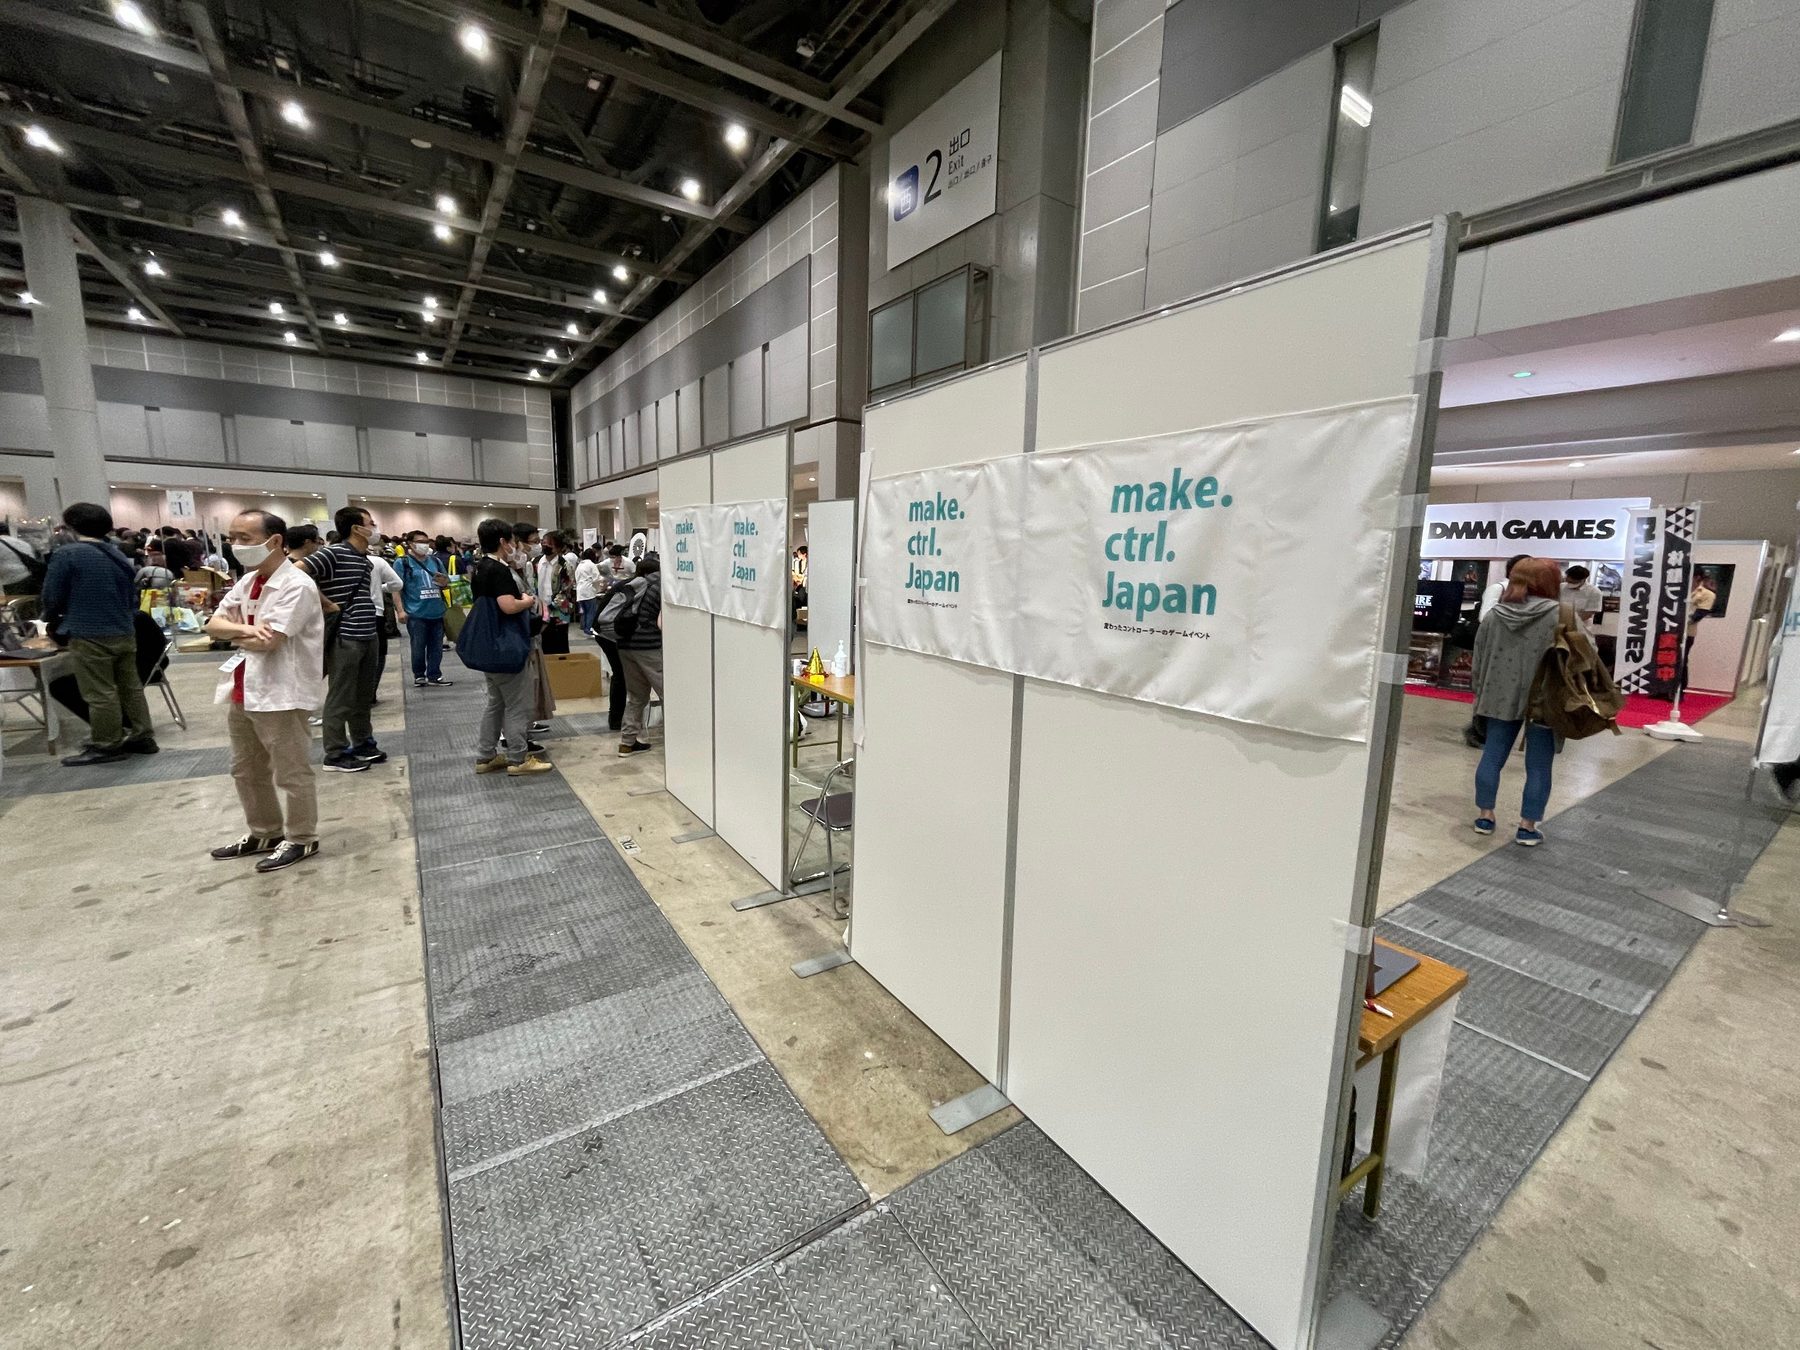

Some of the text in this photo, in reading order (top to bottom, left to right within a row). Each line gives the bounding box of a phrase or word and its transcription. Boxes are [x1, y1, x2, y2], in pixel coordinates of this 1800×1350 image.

[948, 128, 970, 157] 出口
[924, 149, 942, 205] 2
[948, 155, 964, 175] Exit
[909, 491, 965, 522] make.
[1110, 467, 1233, 513] make.
[907, 527, 942, 556] ctrl.
[1104, 520, 1176, 562] ctrl.
[1428, 519, 1616, 540] DMM GAMES
[905, 562, 960, 597] Japan
[1102, 571, 1217, 622] Japan
